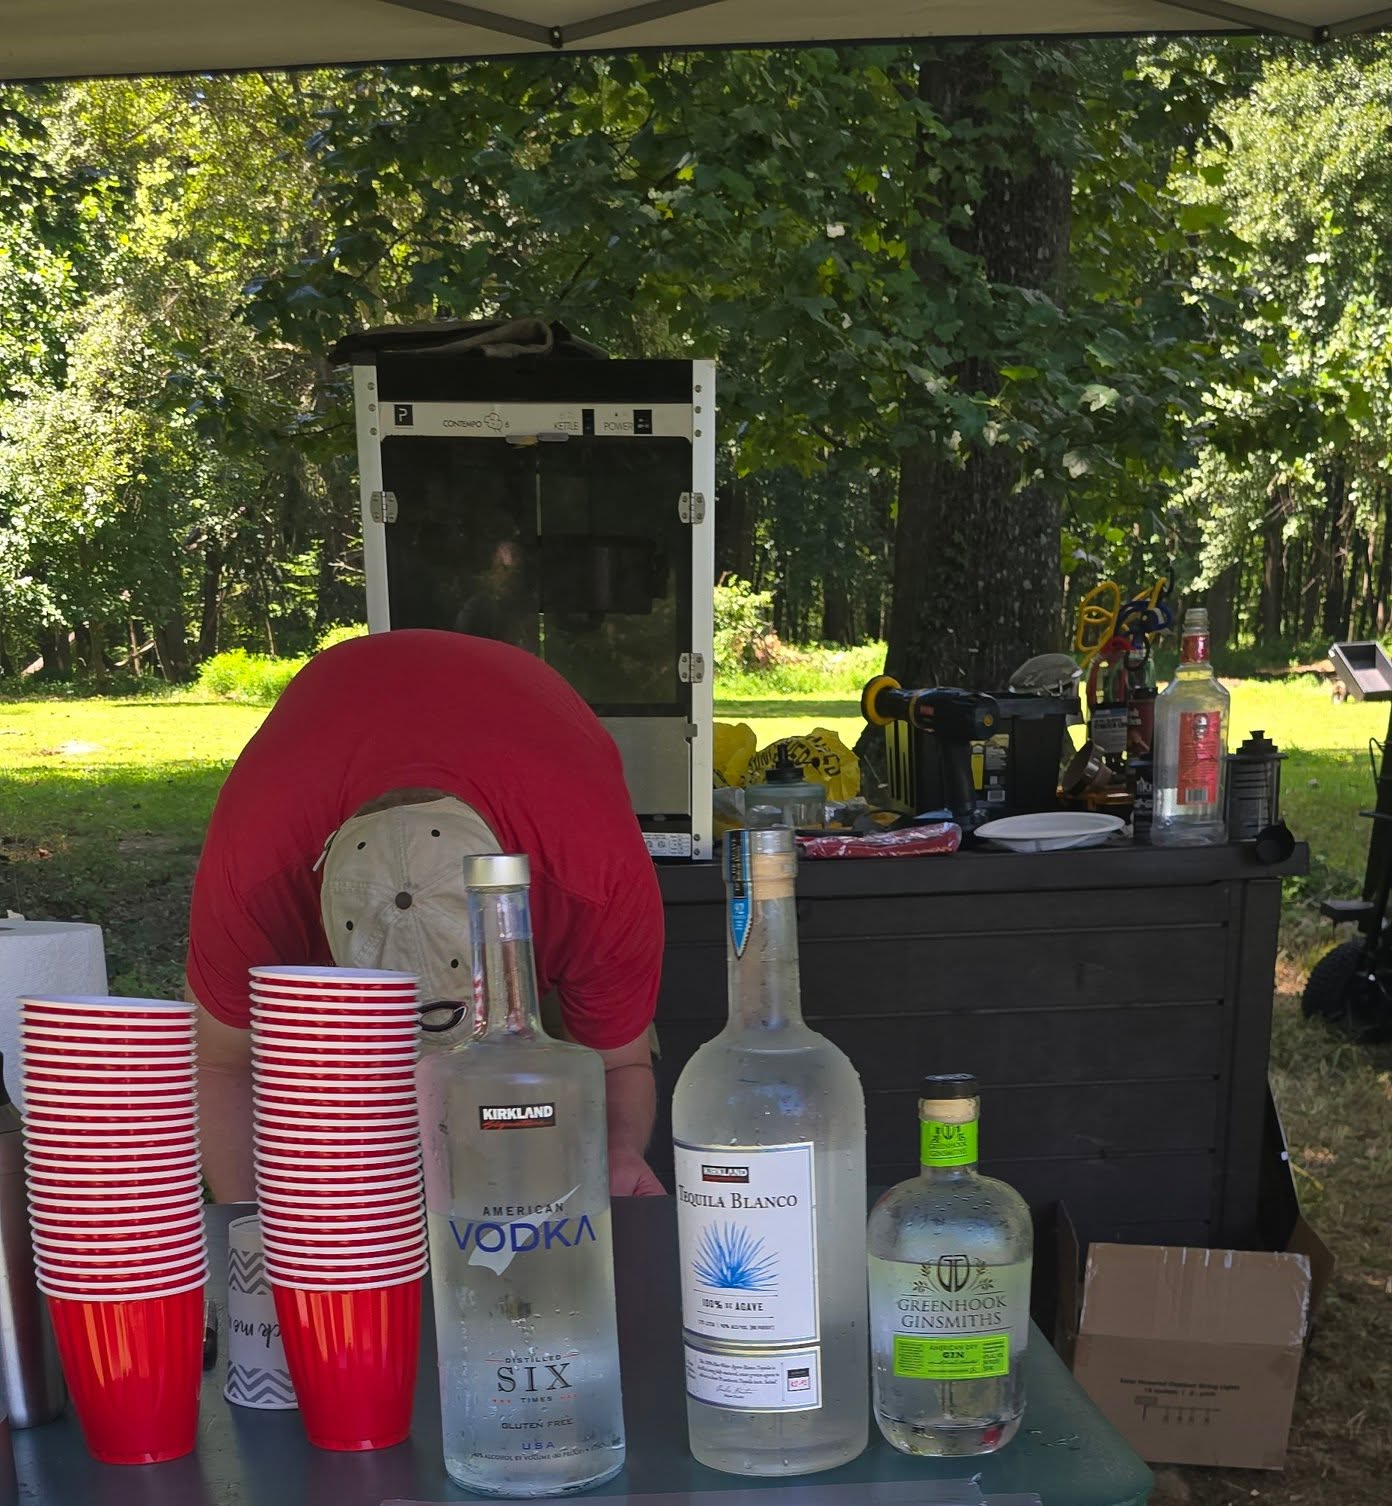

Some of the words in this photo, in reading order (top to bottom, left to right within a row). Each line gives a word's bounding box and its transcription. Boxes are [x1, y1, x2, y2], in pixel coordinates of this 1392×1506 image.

[443, 420, 482, 428] CONTEMPO
[554, 421, 578, 430] KETTLE
[604, 422, 633, 431] POWER
[483, 1105, 553, 1120] KIRKLAND
[730, 1193, 798, 1209] BLANCO
[483, 1203, 564, 1216] AMERICAN
[448, 1215, 596, 1253] VODKA
[897, 1295, 1008, 1312] GREENHOOK
[901, 1312, 1001, 1329] GINSMITHS
[258, 1323, 281, 1349] ck
[505, 1354, 561, 1363] DISTILLED
[942, 1351, 965, 1359] GIN
[497, 1362, 573, 1392] SIX
[520, 1396, 552, 1404] TIMES
[501, 1422, 543, 1430] GLUTEN
[547, 1418, 573, 1428] FREE
[522, 1441, 555, 1450] USA
